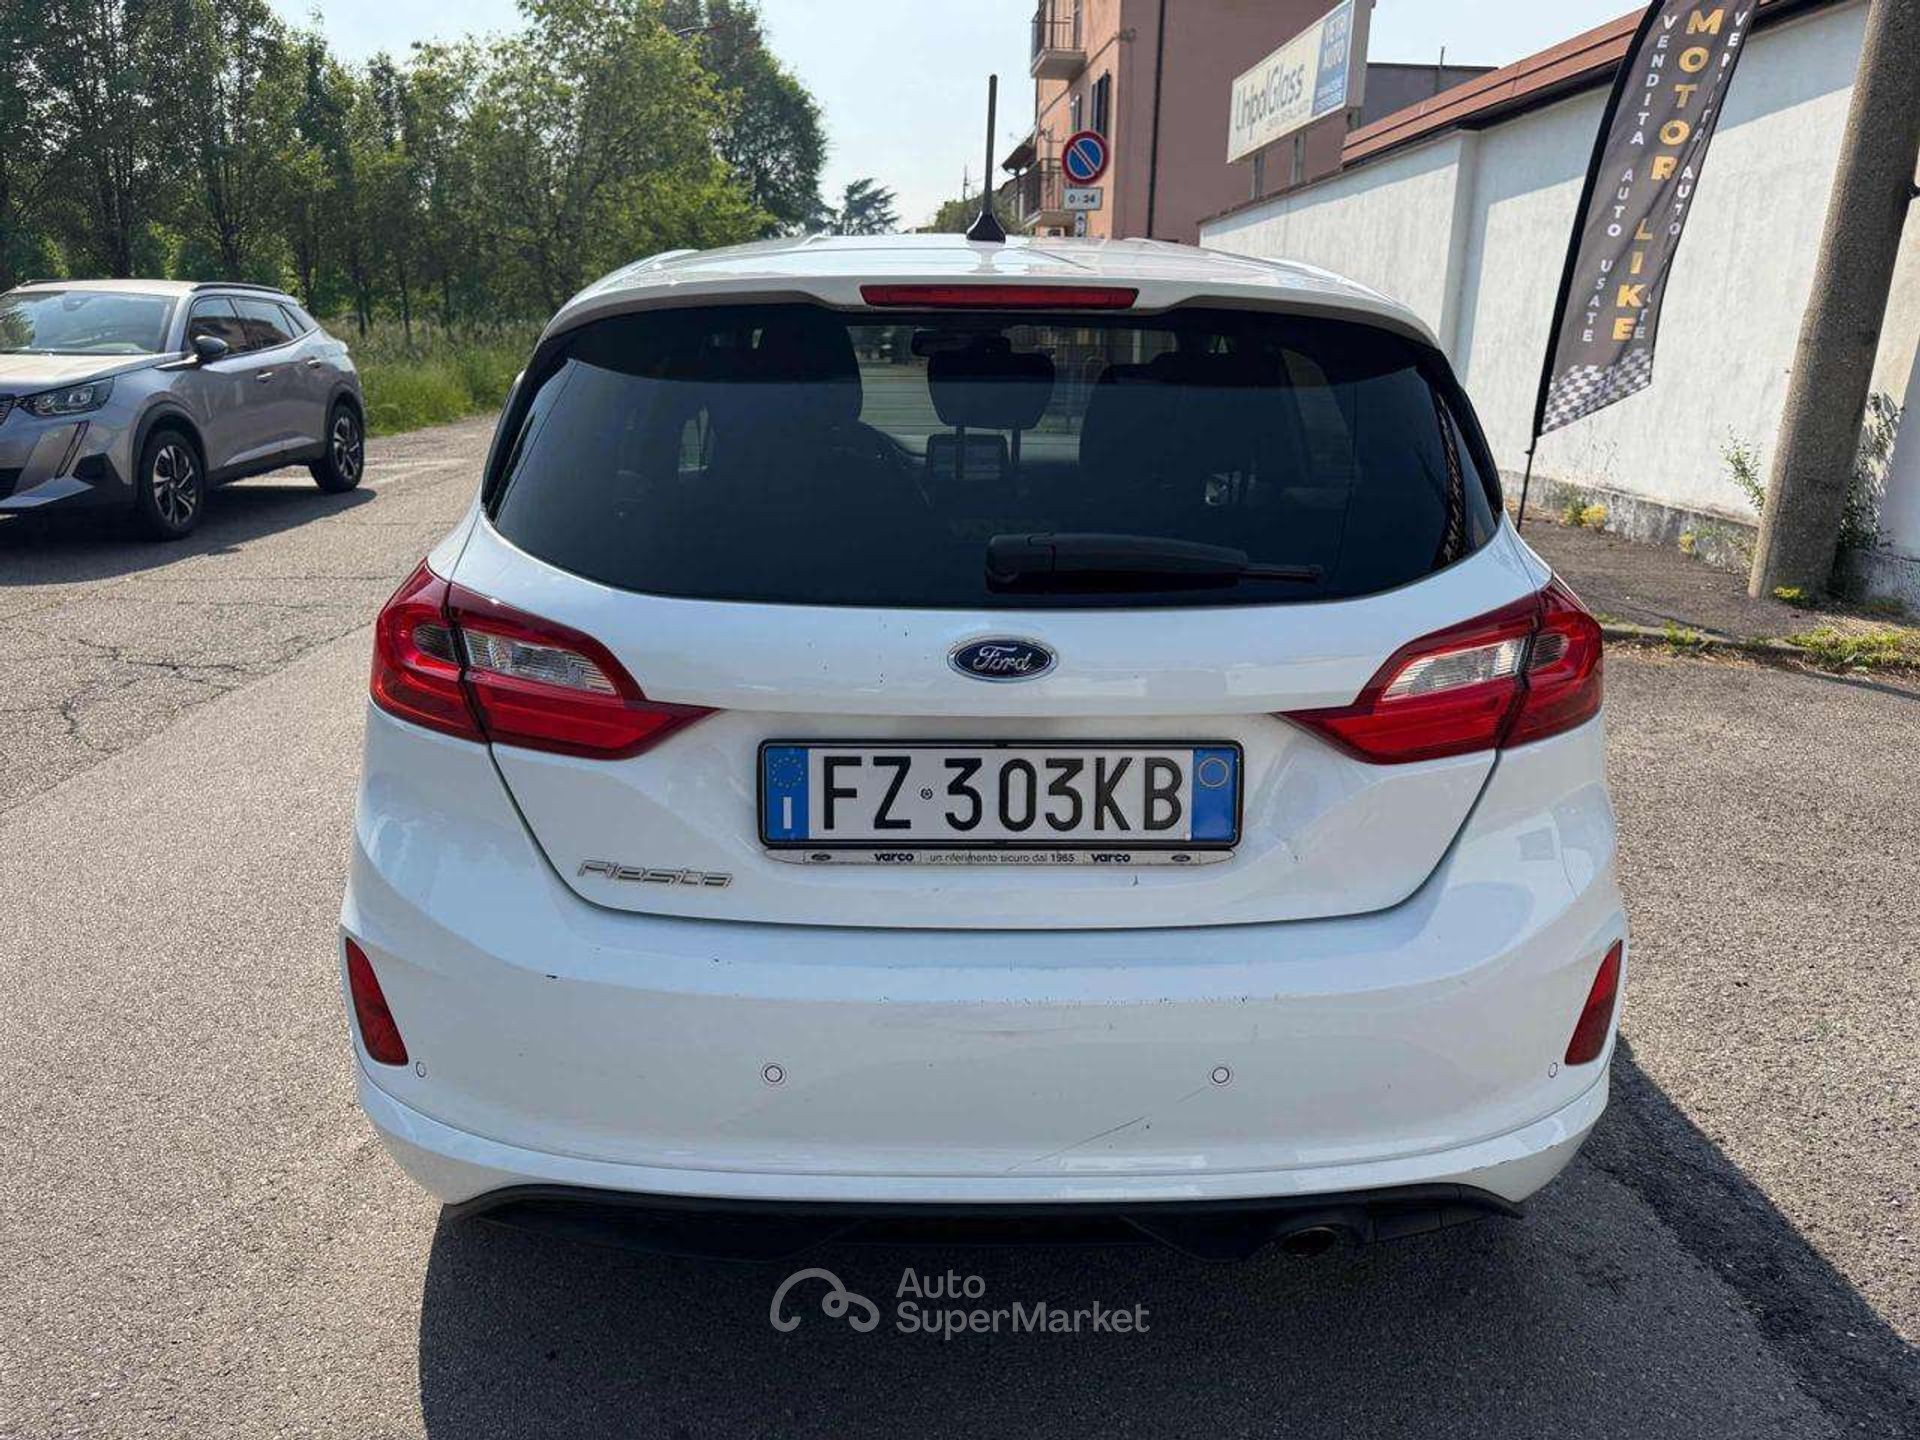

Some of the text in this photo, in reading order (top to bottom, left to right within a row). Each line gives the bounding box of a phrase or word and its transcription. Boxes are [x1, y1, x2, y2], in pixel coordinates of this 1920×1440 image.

[1651, 8, 1725, 181] MOTOR
[1582, 15, 1678, 342] VENDITA AUTO USATE
[1612, 217, 1654, 340] LIKE
[972, 645, 1032, 671] Ford
[577, 859, 733, 888] Fiesta
[874, 852, 915, 862] varco
[1091, 853, 1131, 863] varco
